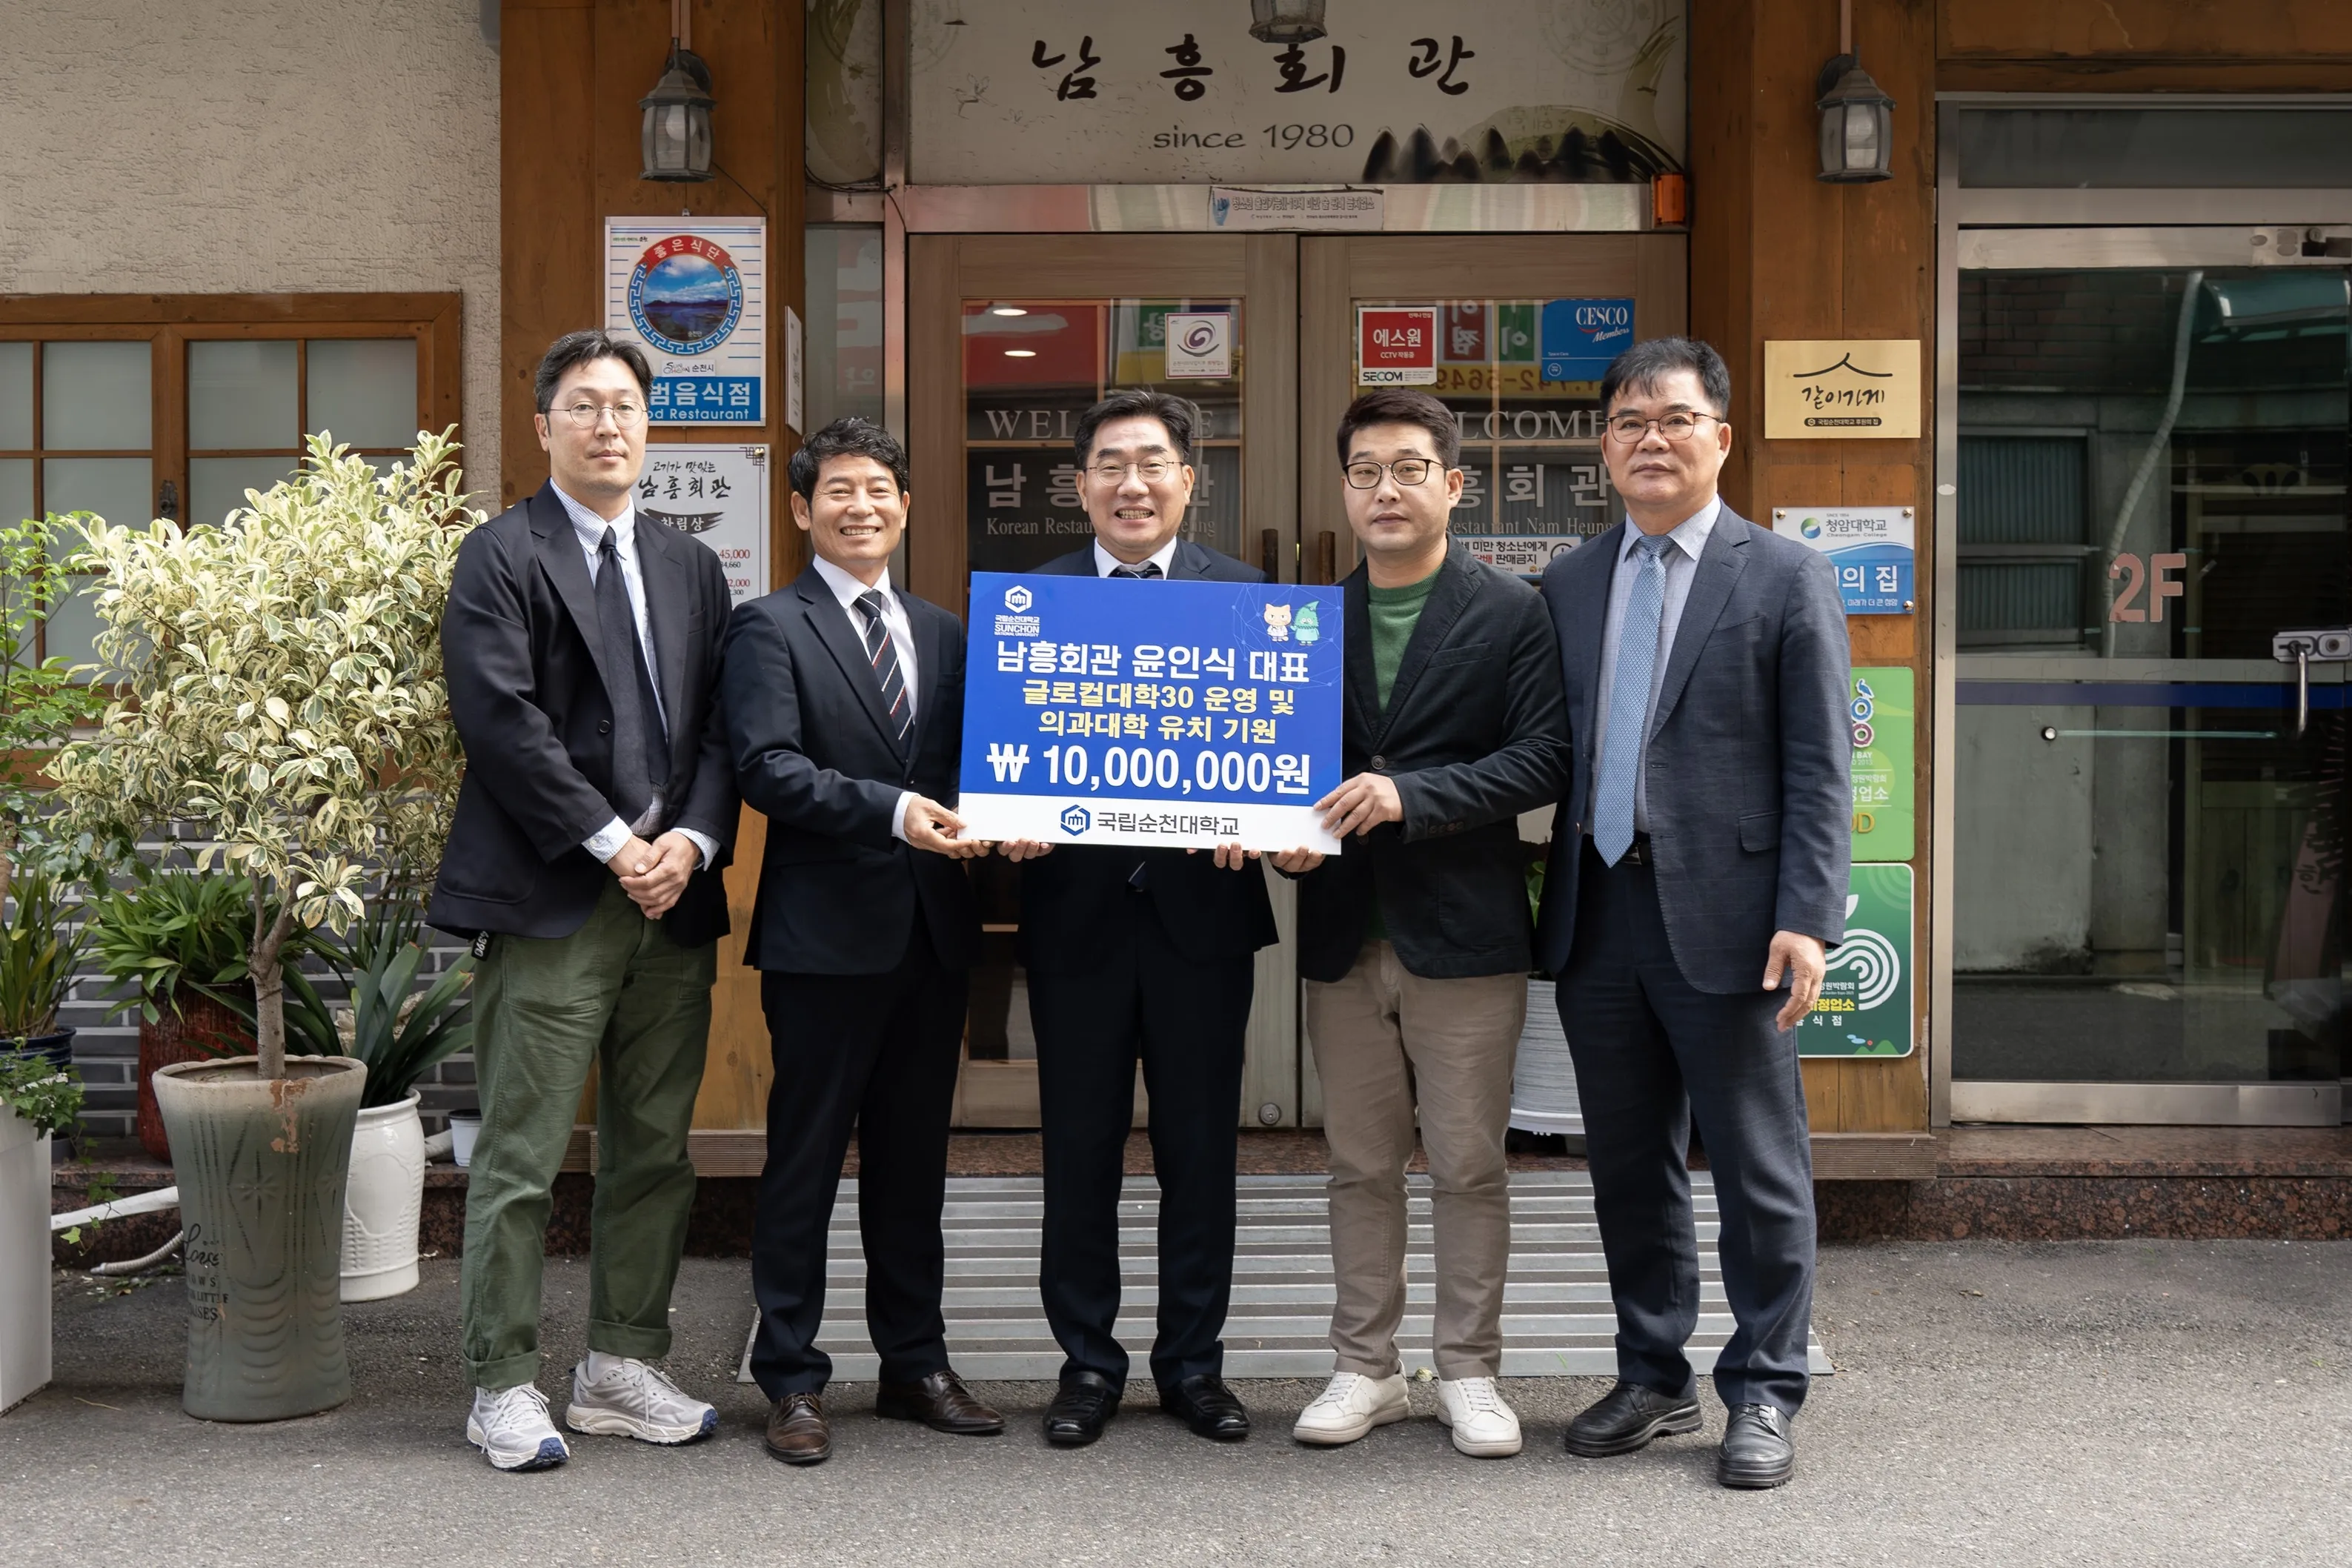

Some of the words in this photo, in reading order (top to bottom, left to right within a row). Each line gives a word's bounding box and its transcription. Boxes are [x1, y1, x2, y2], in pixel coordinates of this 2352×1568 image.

[1153, 124, 1247, 148] since
[1262, 124, 1355, 150] 1980
[1575, 307, 1628, 325] CESCO
[1373, 328, 1421, 348] 에스원
[1592, 327, 1630, 343] Members
[691, 364, 714, 372] 순천시
[1363, 371, 1403, 382] SECOM
[650, 382, 751, 406] 범음식점
[669, 408, 749, 419] Restaurant
[1455, 410, 1605, 439] LCOME
[653, 461, 681, 473] 고기가
[685, 461, 717, 473] 맛있는
[987, 518, 1039, 535] Korean
[1045, 517, 1095, 535] Restau
[1527, 517, 1560, 534] Nam
[1826, 519, 1887, 533] 청암대학교
[719, 549, 751, 559] 45,000
[1472, 541, 1494, 553] 미만
[1495, 541, 1548, 553] 청소년에게
[1495, 554, 1537, 565] 판매금지
[727, 578, 751, 588] 2,000
[1875, 565, 1898, 593] 집
[2108, 552, 2187, 622] 2F
[1847, 598, 1867, 606] 미래가
[1884, 598, 1898, 607] 청암
[995, 614, 1040, 623] 국립순천대학교
[994, 624, 1040, 634] SUNCHON
[997, 640, 1122, 676] 남흥회관
[1132, 644, 1235, 682] 윤인식
[1249, 651, 1309, 683] 대표
[1023, 680, 1194, 710] 글로컬대학30
[1203, 686, 1258, 714] 운영
[1269, 689, 1295, 716] 및
[1038, 711, 1149, 740] 의과대학
[1158, 716, 1212, 743] 유치
[1223, 718, 1277, 745] 기원
[1043, 745, 1311, 795] 10,000,000원
[1852, 774, 1887, 783] 정원박람회
[1097, 812, 1240, 837] 국립순천대학교
